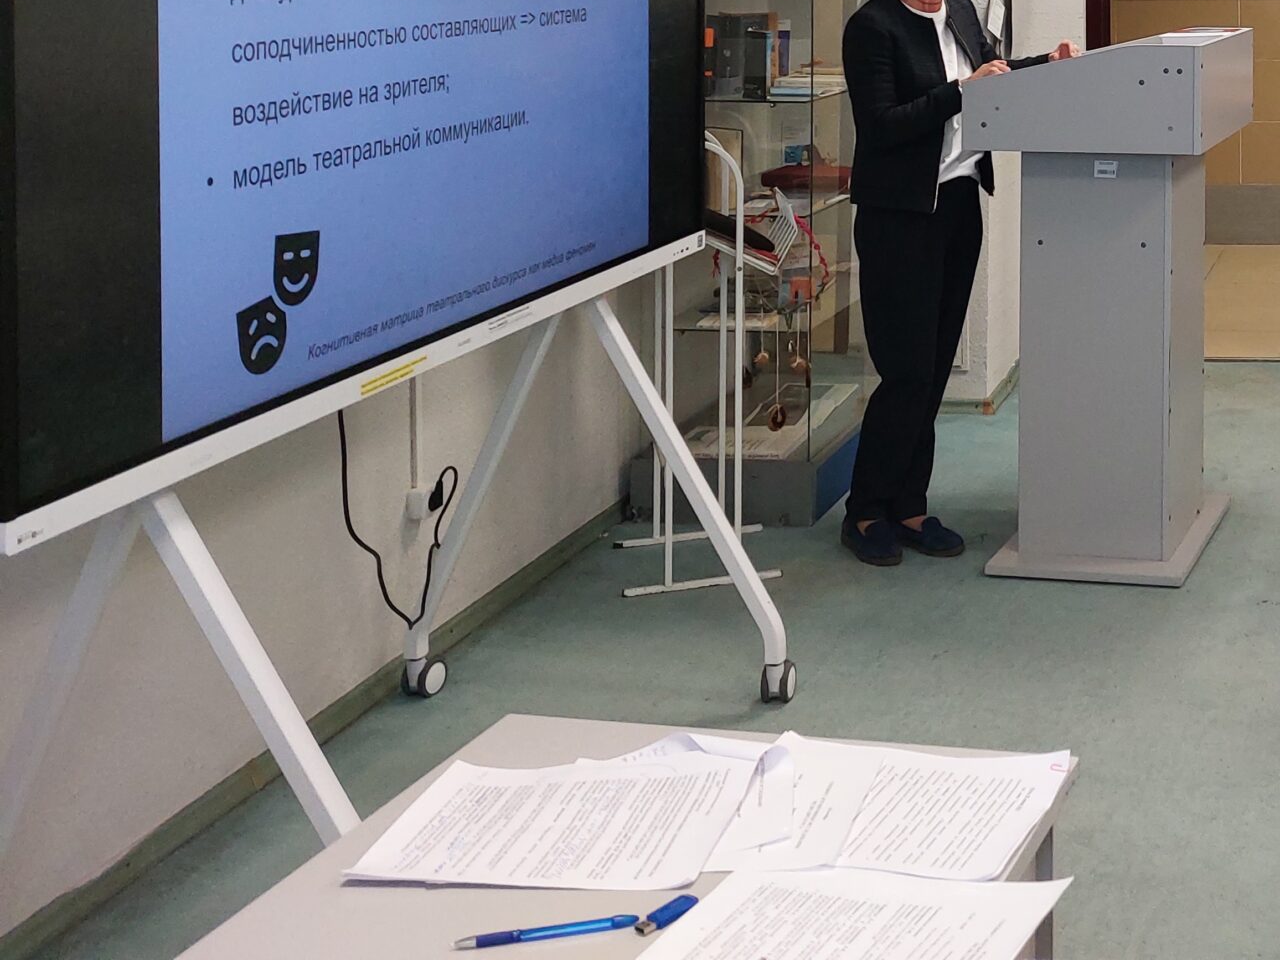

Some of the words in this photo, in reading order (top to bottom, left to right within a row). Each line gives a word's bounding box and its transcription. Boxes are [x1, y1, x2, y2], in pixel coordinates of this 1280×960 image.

[231, 25, 407, 64] соподчиненностью
[411, 13, 517, 42] составляющих
[539, 7, 588, 27] система
[232, 89, 354, 127] воздействие
[358, 84, 379, 106] на
[383, 73, 450, 106] зрителя;
[232, 156, 307, 189] модель
[312, 127, 421, 171] театральной
[425, 109, 530, 147] коммуникации.
[307, 323, 379, 361] Когнитивная
[380, 306, 424, 333] матрица
